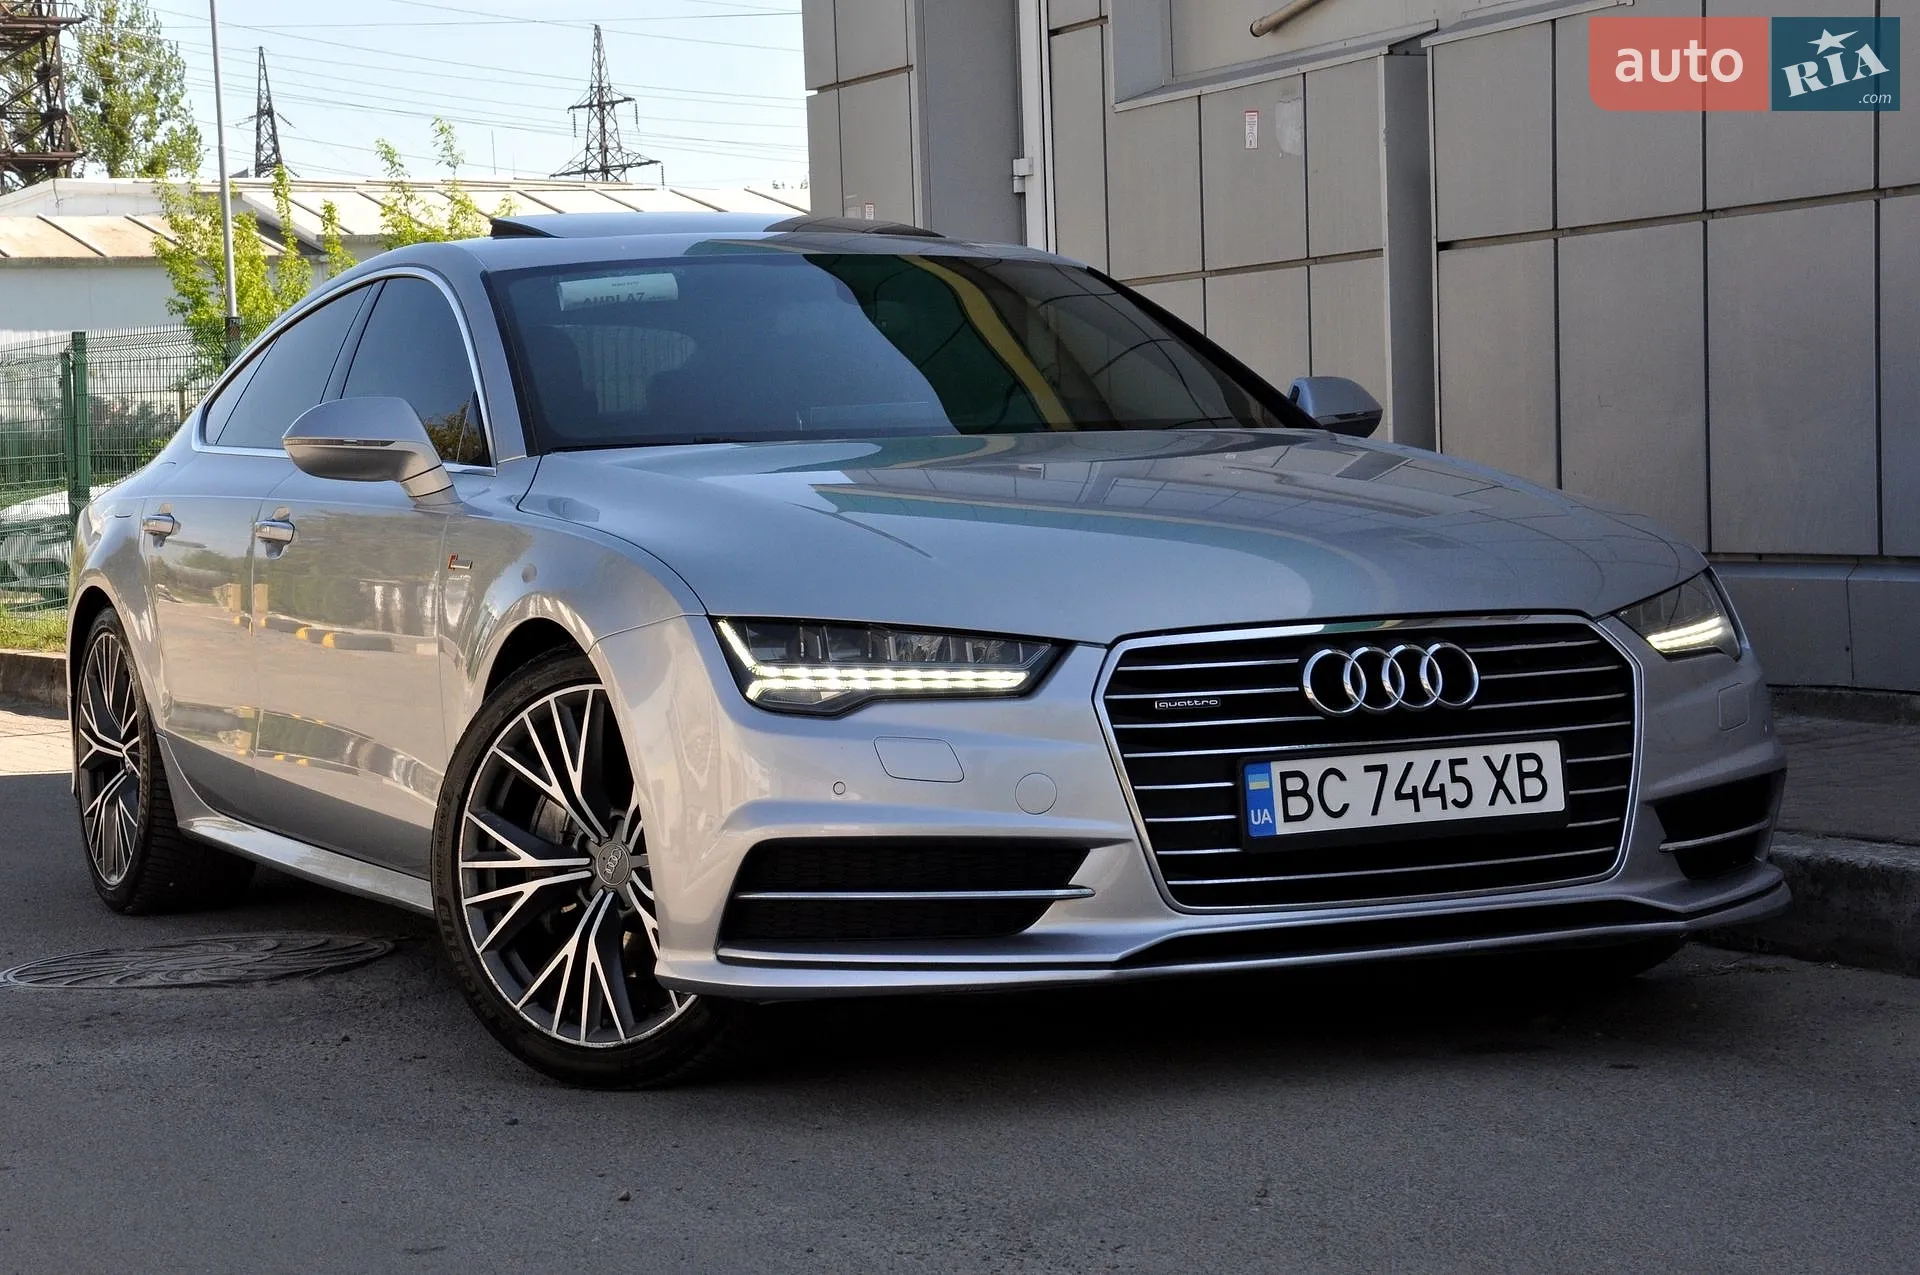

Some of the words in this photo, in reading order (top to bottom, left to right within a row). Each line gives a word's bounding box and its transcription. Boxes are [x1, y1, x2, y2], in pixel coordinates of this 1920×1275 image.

[1159, 699, 1218, 709] quattro
[1279, 767, 1350, 823] BC
[1363, 757, 1474, 816] 7445
[1482, 752, 1548, 806] XB
[1251, 808, 1273, 825] UA
